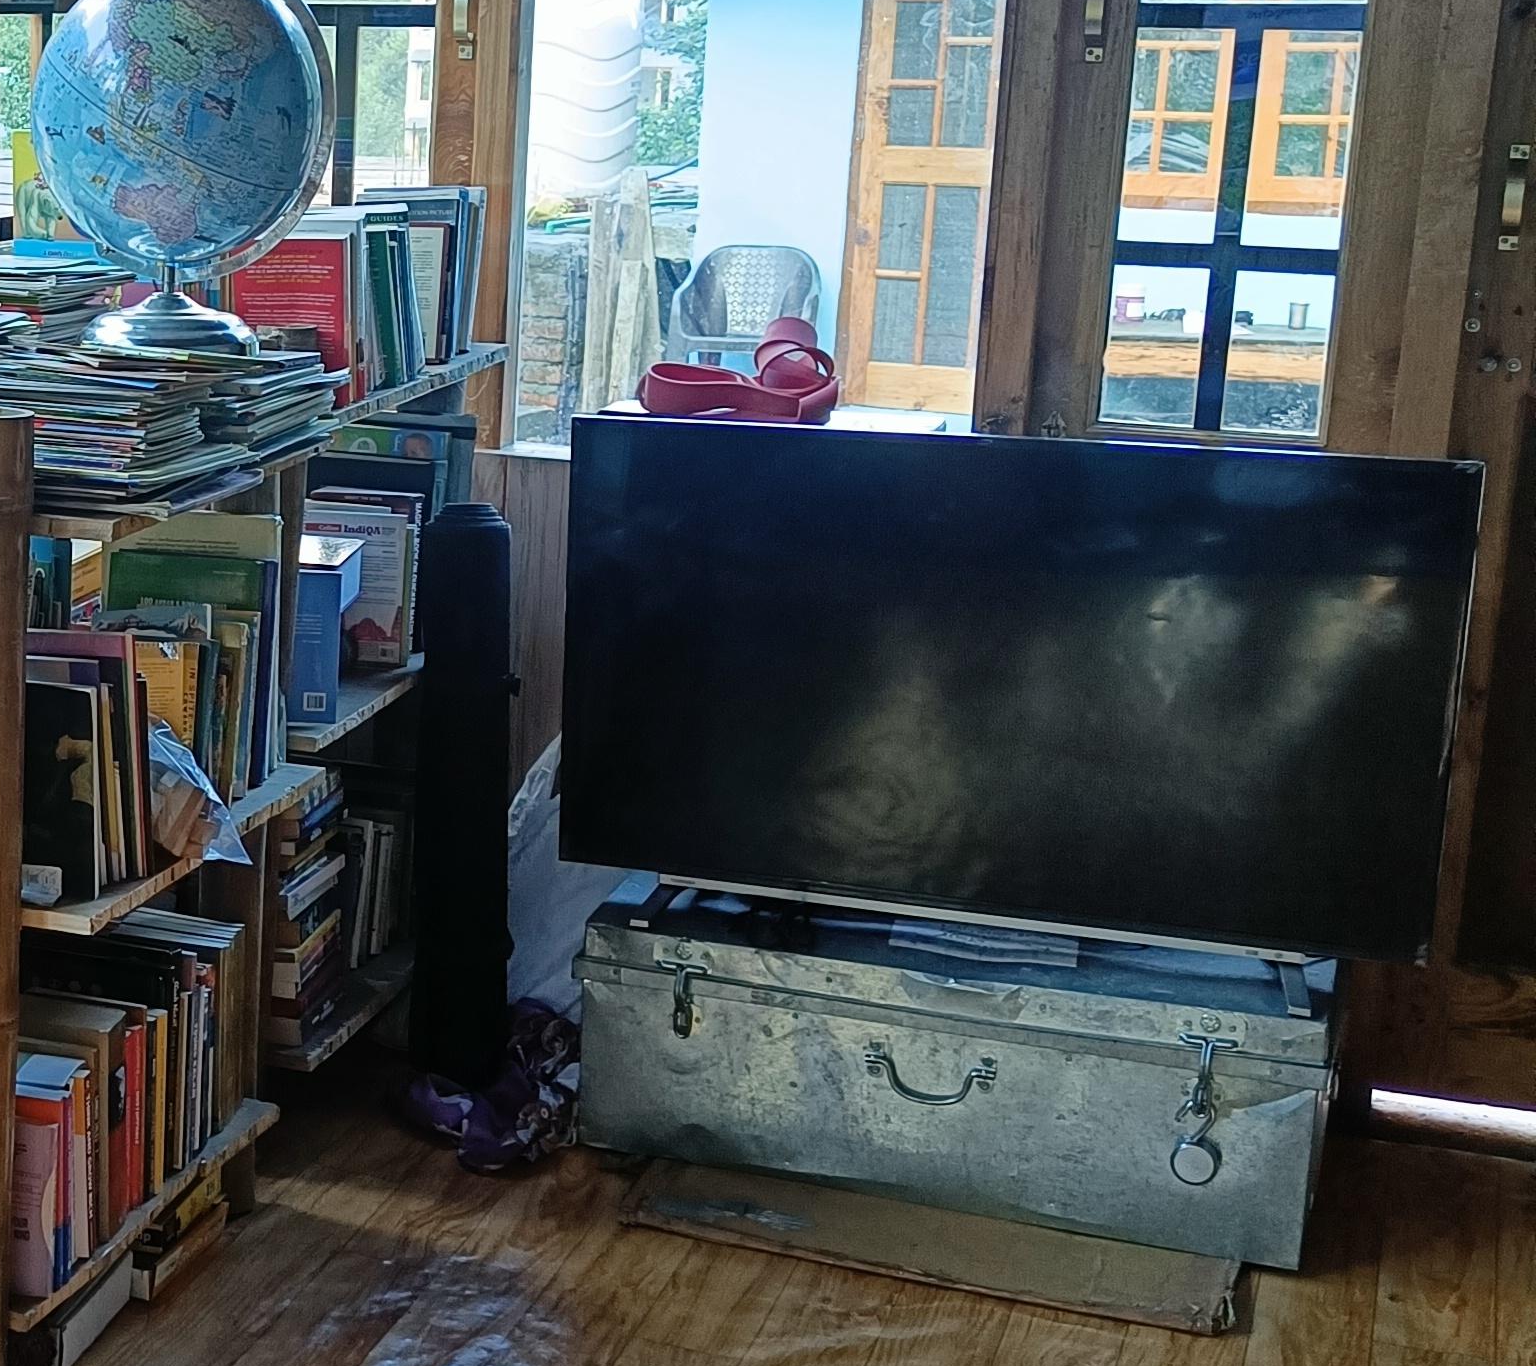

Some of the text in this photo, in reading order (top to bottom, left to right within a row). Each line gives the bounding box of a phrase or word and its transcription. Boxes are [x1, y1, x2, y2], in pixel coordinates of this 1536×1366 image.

[414, 502, 423, 534] MAGICAL
[343, 524, 381, 537] IndiQA
[85, 1131, 93, 1155] AND
